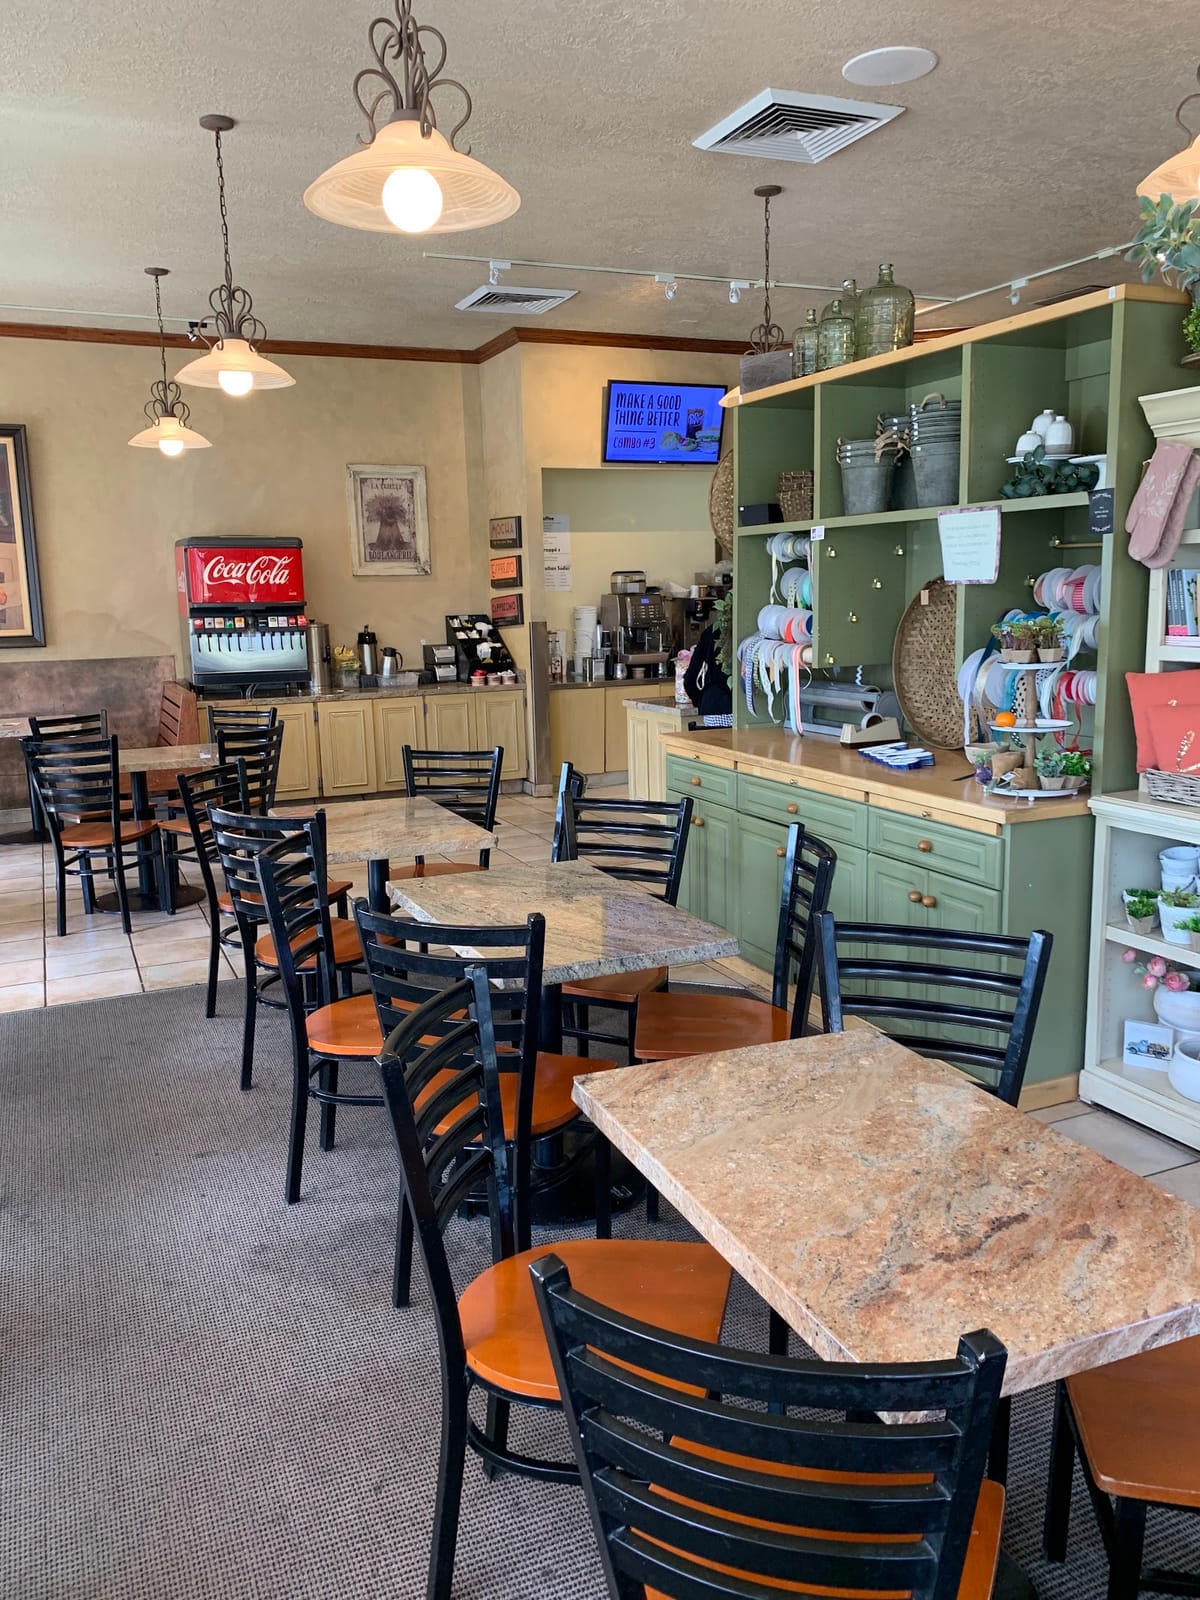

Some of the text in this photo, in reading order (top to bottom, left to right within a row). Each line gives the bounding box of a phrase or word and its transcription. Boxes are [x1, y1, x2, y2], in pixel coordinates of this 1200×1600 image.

[616, 391, 682, 410] MAKE A GOOD
[615, 409, 644, 426] THING
[647, 410, 680, 427] BETTER
[643, 437, 656, 450] #3
[203, 555, 294, 585] Coca-Cola
